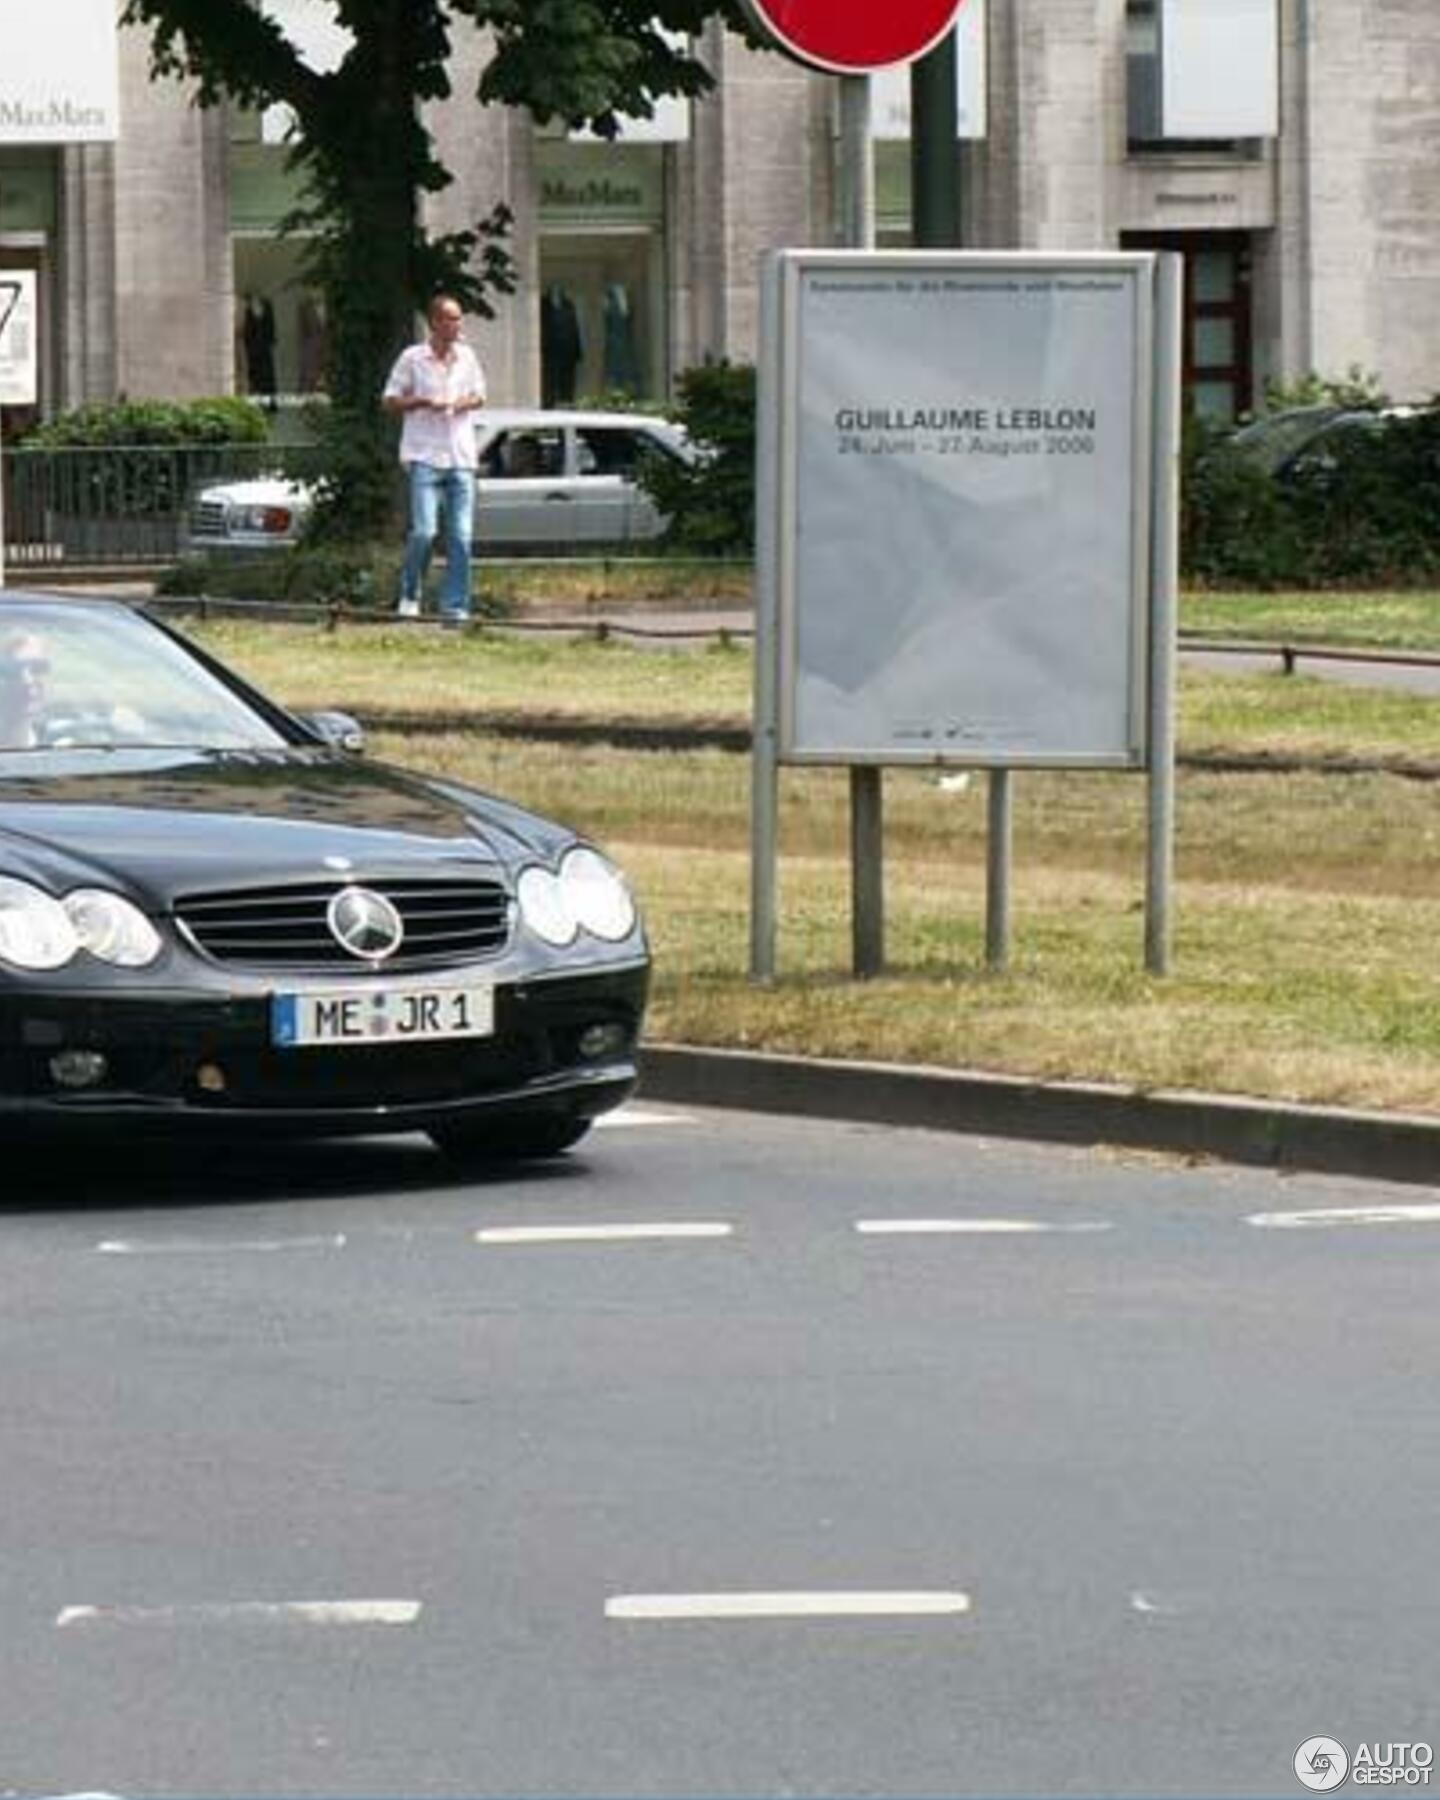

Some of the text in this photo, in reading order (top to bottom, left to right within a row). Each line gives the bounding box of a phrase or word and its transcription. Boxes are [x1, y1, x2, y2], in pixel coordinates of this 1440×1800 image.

[540, 179, 642, 206] MaxMara
[835, 409, 1097, 431] GUILLAUME LEBLON
[968, 434, 1041, 457] August
[315, 993, 472, 1037] ME JR 1
